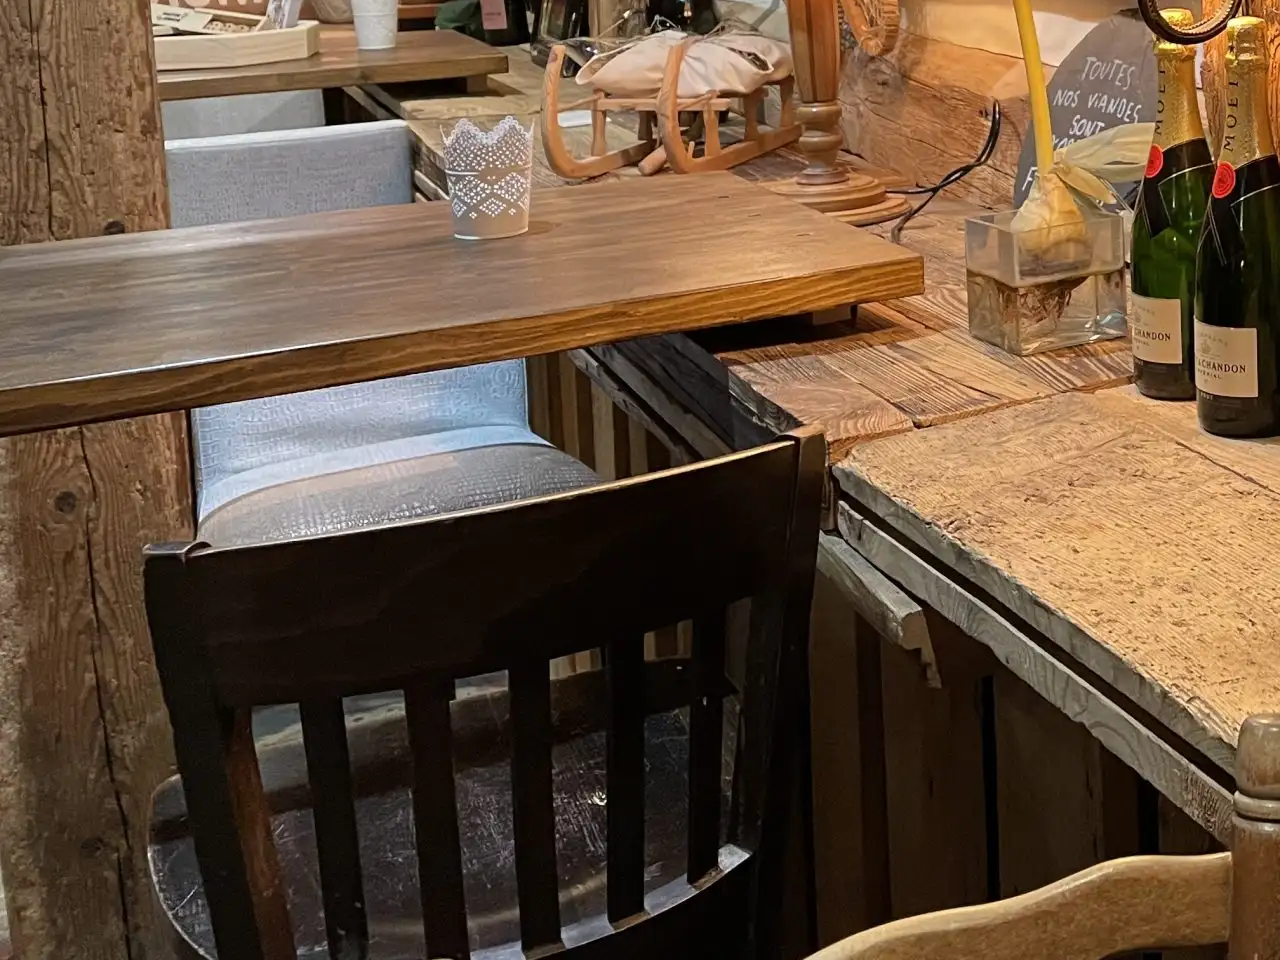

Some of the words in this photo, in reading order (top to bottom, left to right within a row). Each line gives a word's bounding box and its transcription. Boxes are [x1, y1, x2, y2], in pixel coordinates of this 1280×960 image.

[1081, 56, 1136, 90] TOUTES
[1052, 89, 1080, 108] NOS
[1069, 114, 1105, 136] SONT
[1201, 359, 1246, 374] CHANDON
